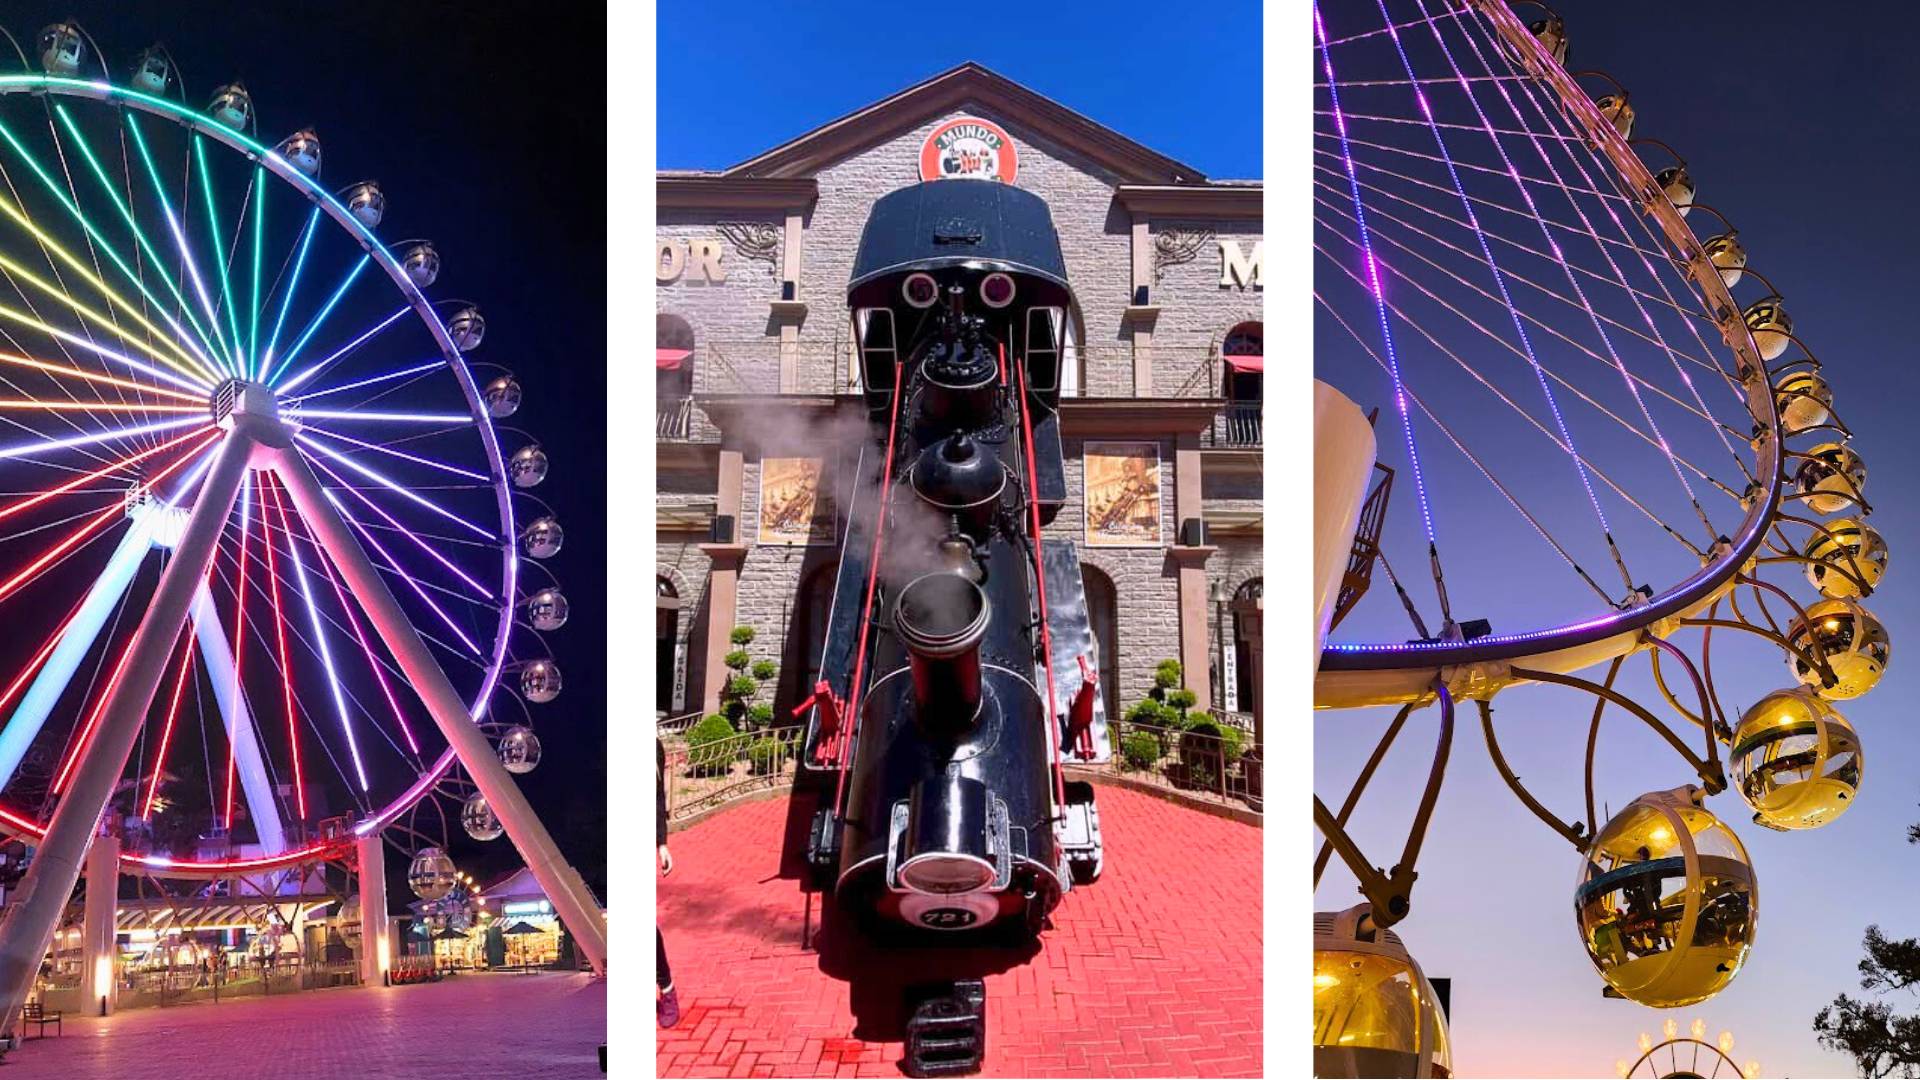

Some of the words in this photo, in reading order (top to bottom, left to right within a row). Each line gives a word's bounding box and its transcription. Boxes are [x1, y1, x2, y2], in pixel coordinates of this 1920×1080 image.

[940, 125, 999, 146] MUNDO
[1227, 653, 1235, 706] ENTRADA
[924, 911, 971, 923] 721
